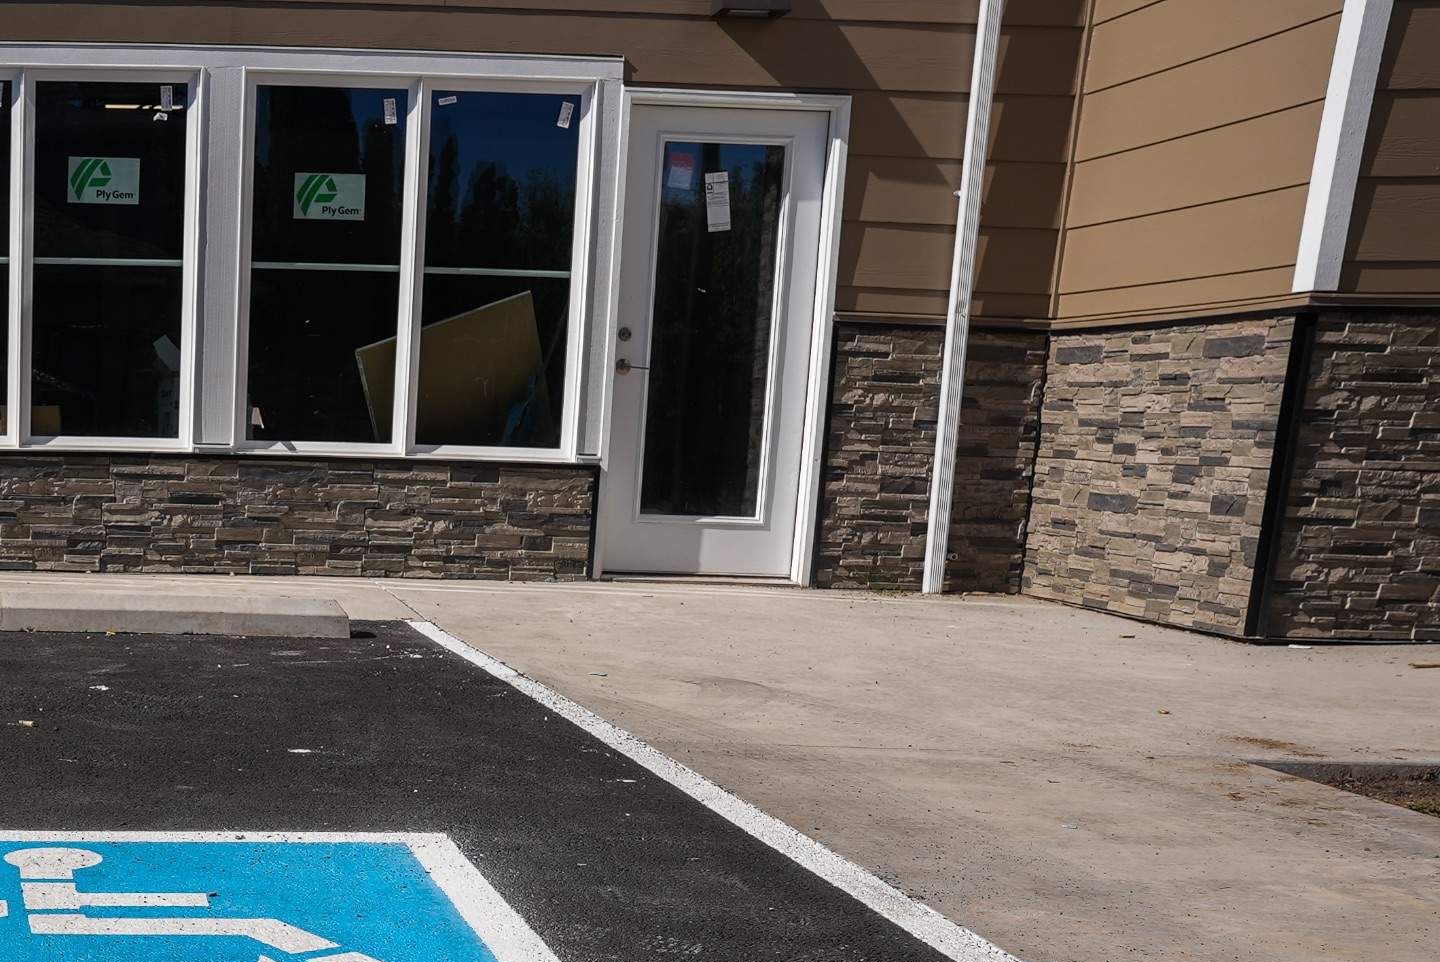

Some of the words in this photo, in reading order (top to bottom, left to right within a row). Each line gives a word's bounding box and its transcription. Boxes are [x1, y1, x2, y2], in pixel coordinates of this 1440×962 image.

[96, 189, 111, 201] Ply
[112, 190, 134, 199] Gem
[321, 206, 337, 216] Ply
[338, 206, 359, 215] Gem
